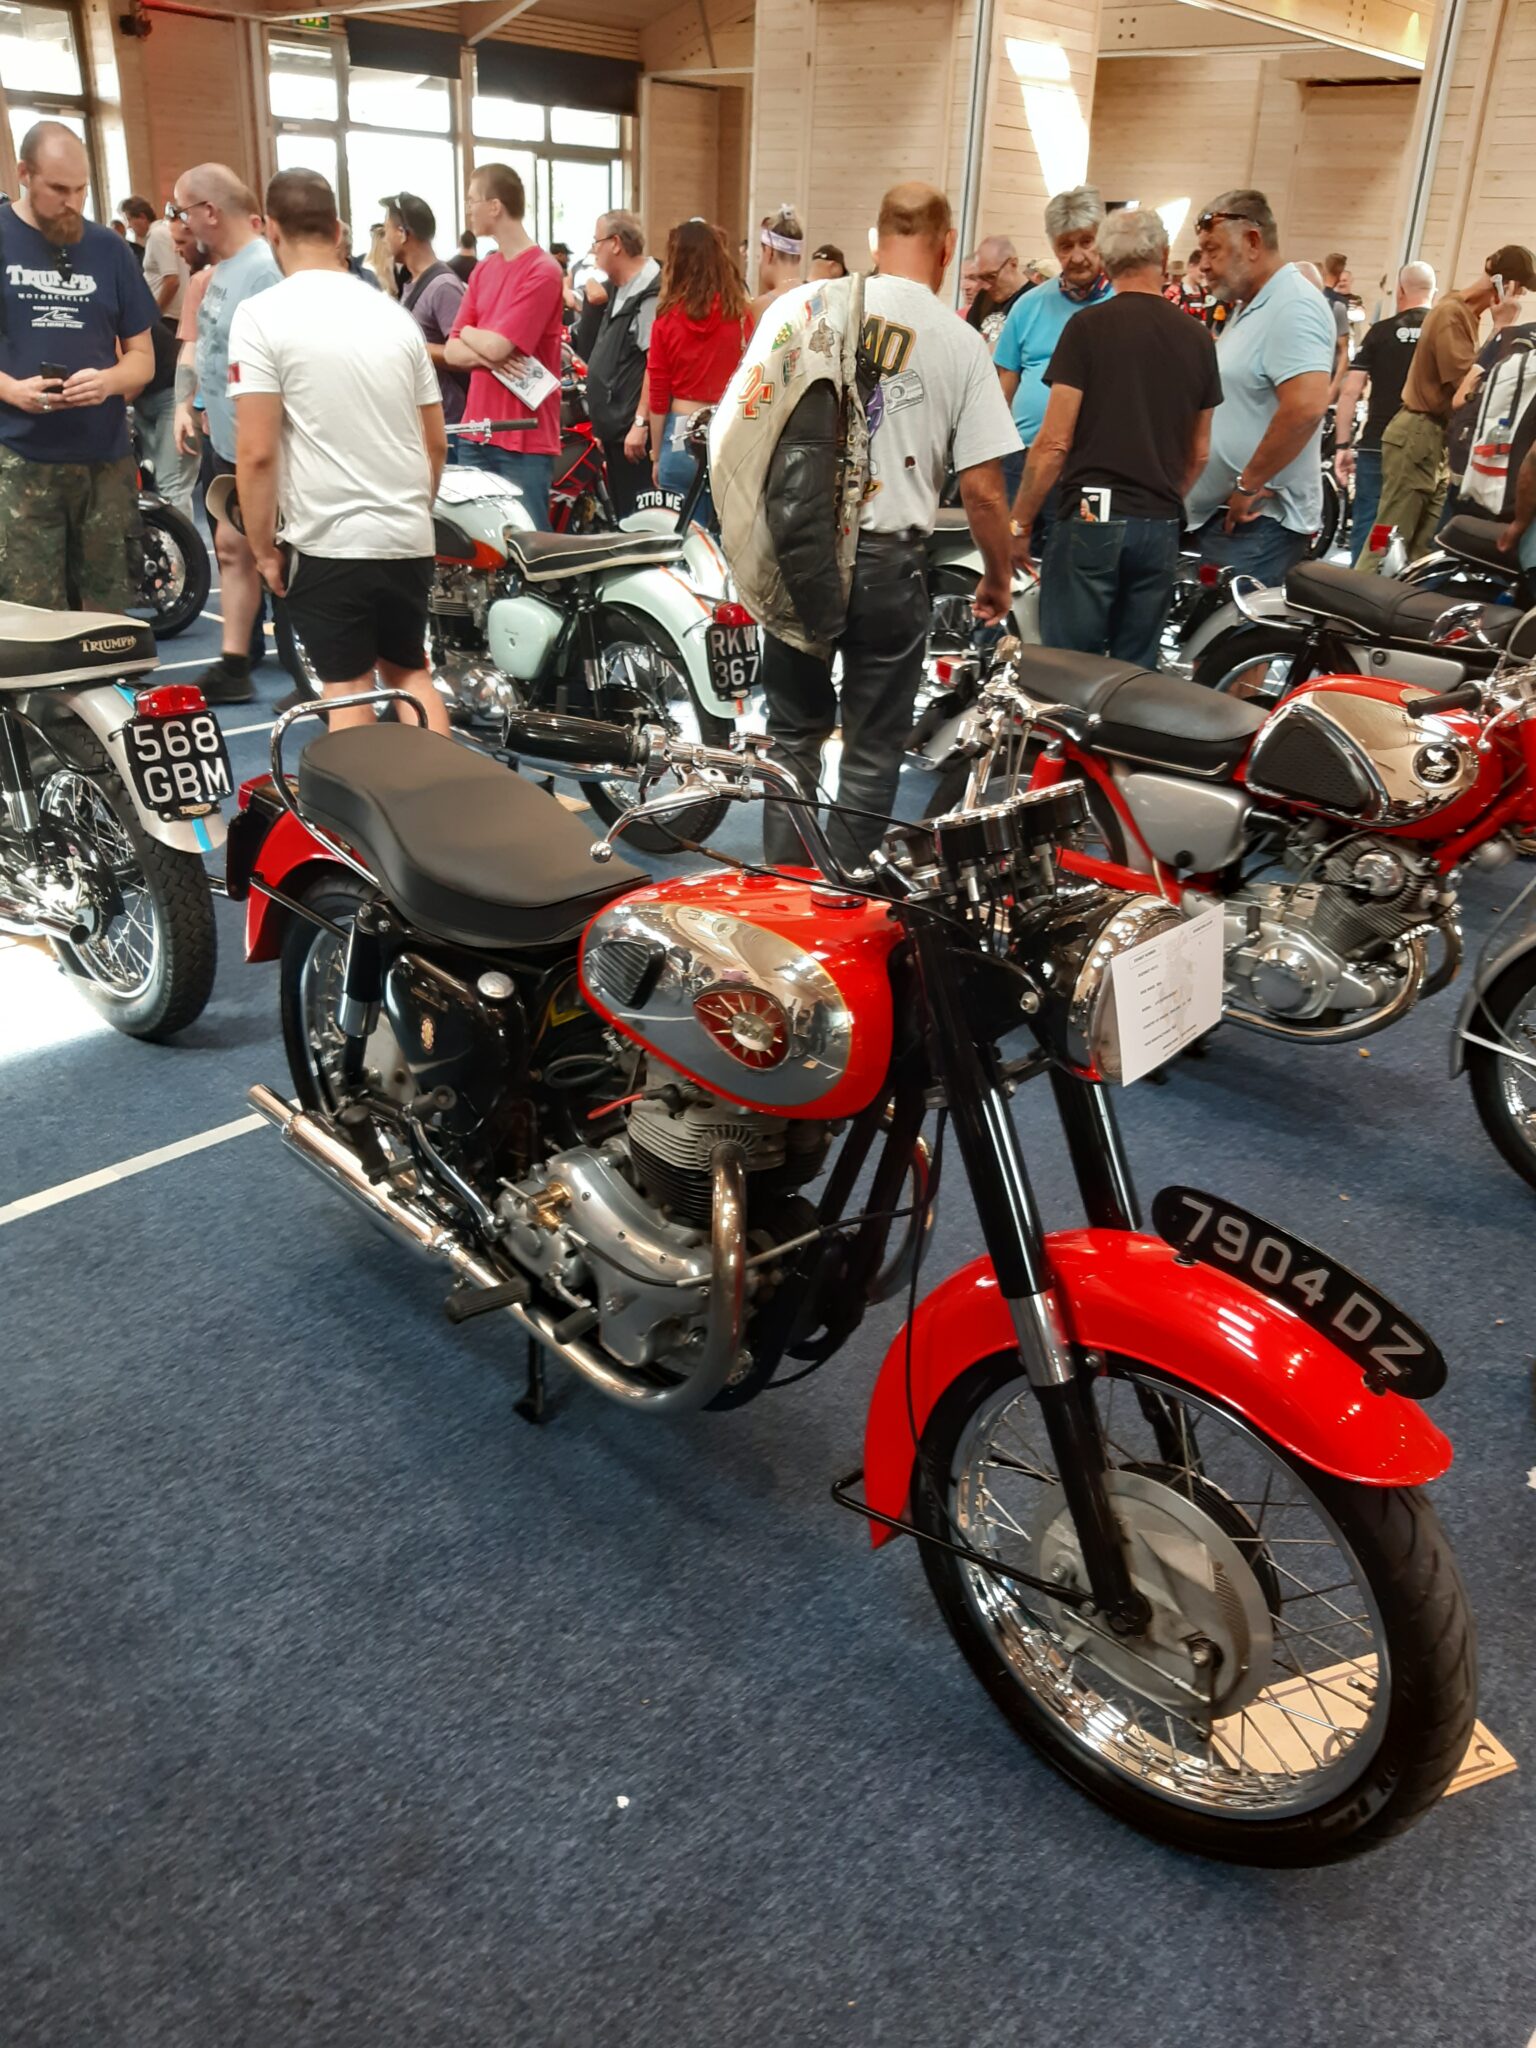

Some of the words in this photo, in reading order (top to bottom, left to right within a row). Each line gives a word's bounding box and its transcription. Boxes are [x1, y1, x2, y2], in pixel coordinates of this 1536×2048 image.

[18, 293, 90, 302] MOTORCYCLES
[636, 491, 663, 510] 2778
[79, 636, 137, 654] TRIUMPH
[711, 625, 757, 658] RKW
[714, 656, 760, 689] 367
[133, 717, 219, 762] 568
[143, 757, 232, 803] GBM
[1182, 1196, 1330, 1307] 7904
[1331, 1292, 1425, 1377] DZ
